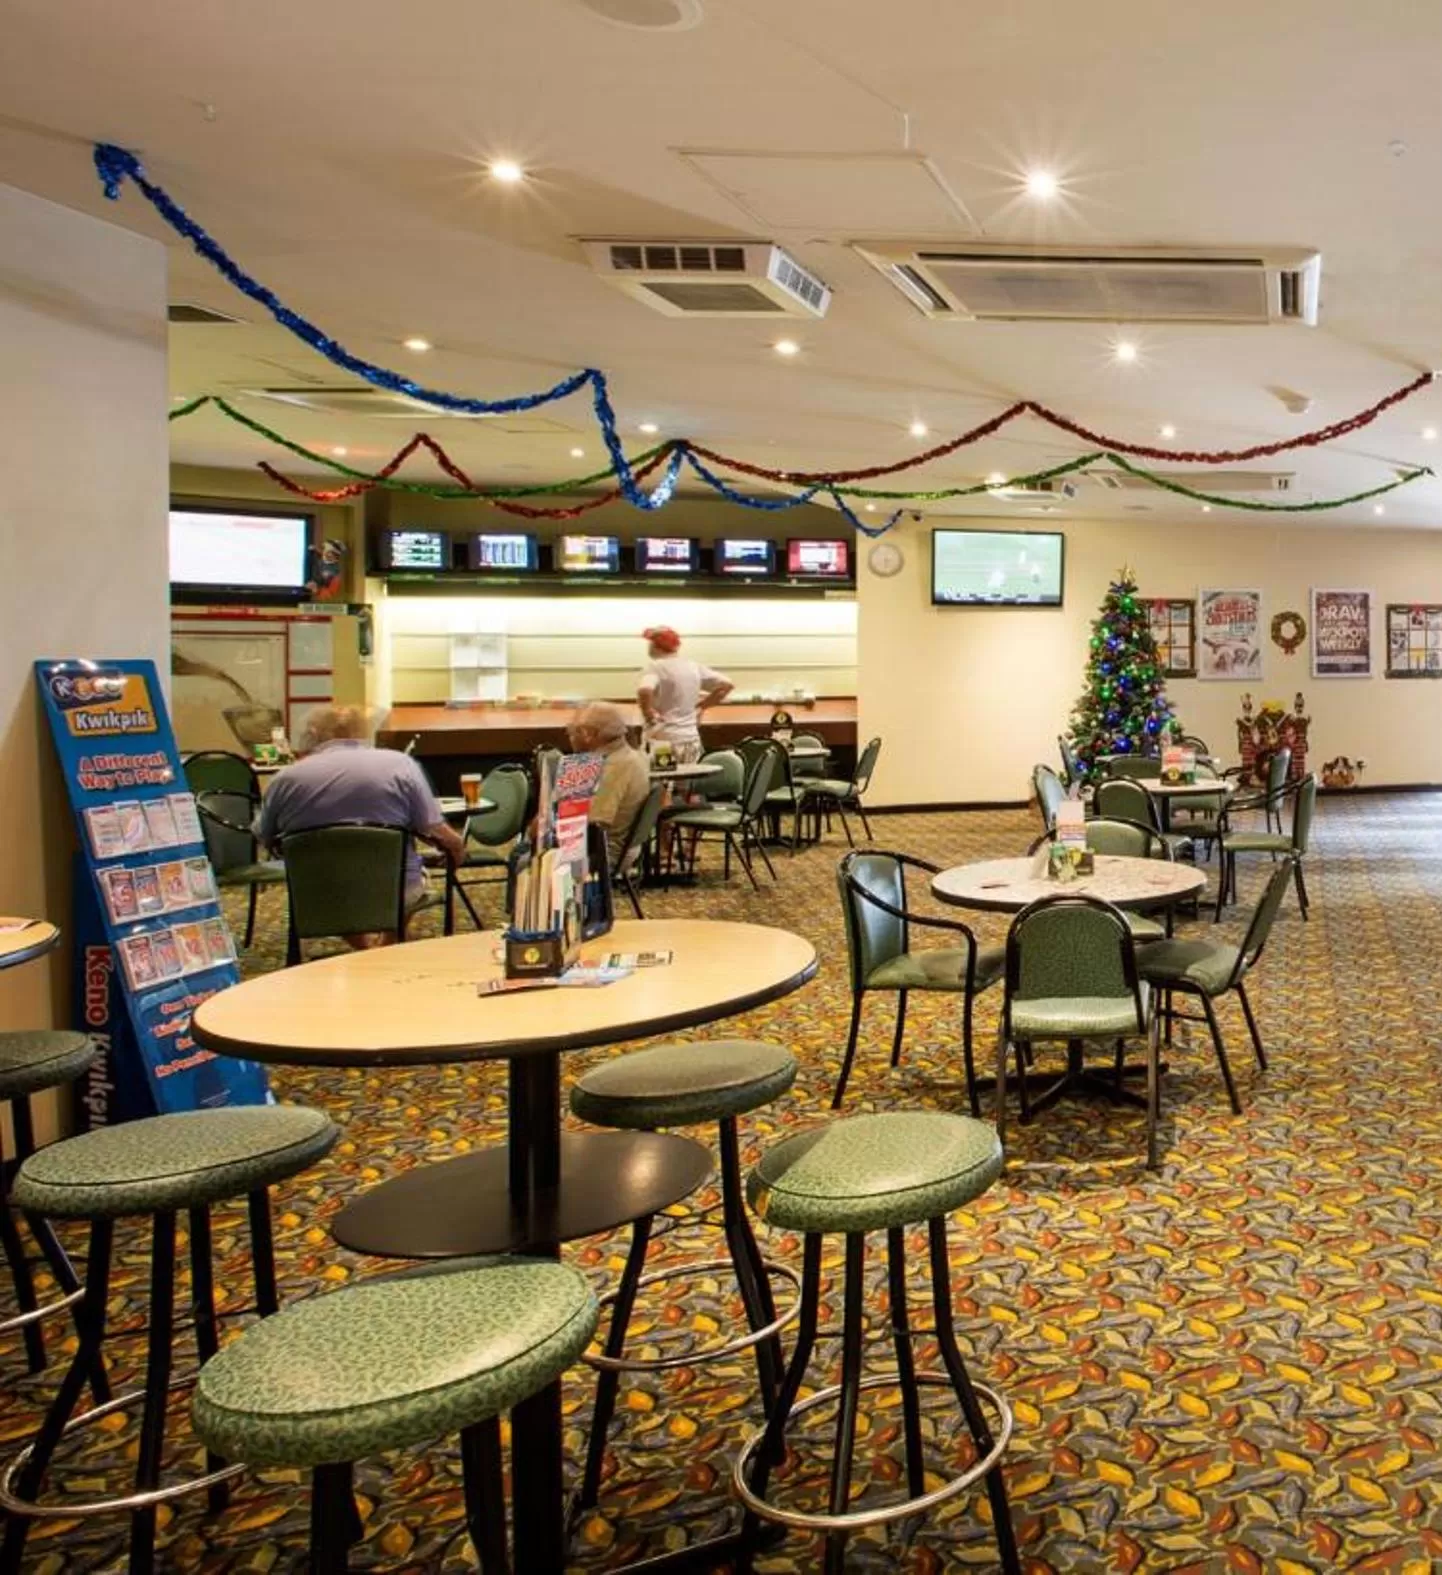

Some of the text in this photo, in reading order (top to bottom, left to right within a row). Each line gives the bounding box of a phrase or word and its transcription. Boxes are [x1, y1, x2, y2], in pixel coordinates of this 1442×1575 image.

[75, 709, 149, 732] Kwikpik
[85, 945, 114, 1026] Keno
[82, 1032, 115, 1129] Kwikpi
